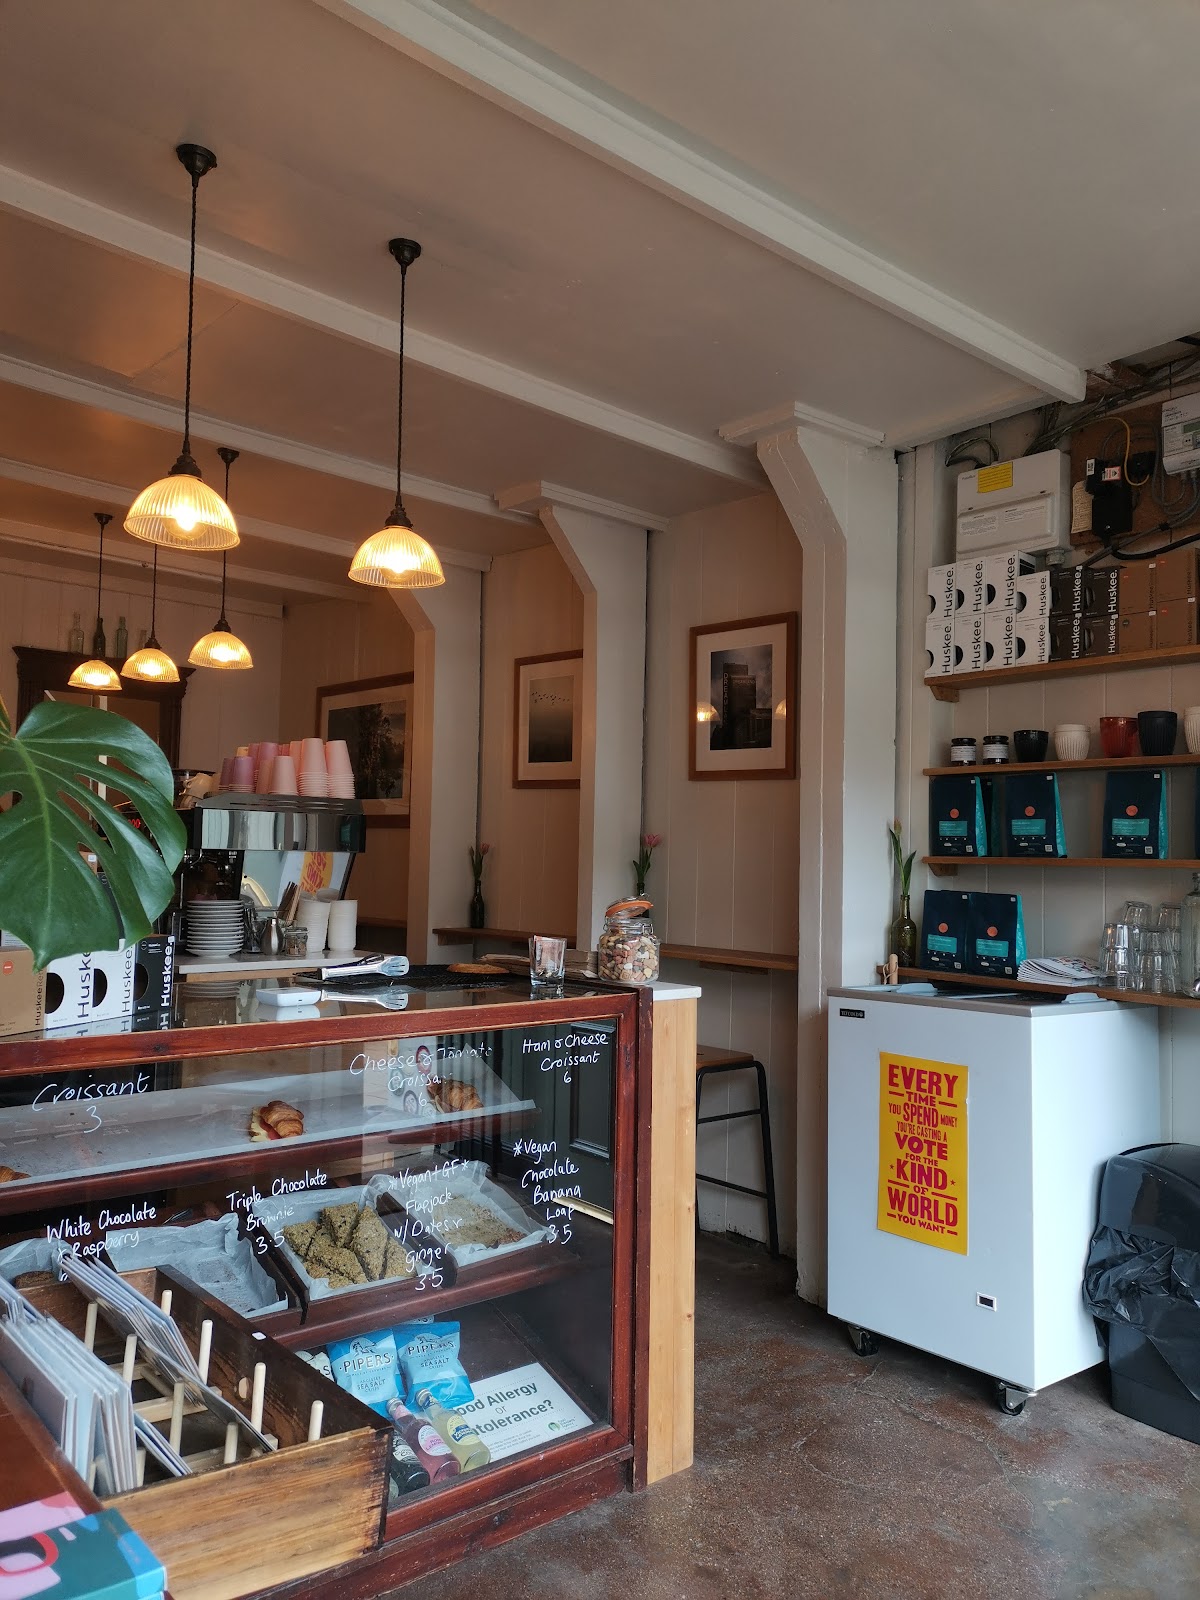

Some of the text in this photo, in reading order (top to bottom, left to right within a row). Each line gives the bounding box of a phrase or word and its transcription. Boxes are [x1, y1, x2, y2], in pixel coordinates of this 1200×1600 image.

[944, 567, 954, 618] Huskee.
[973, 560, 983, 612] Huskee.
[1005, 554, 1016, 607] Huskee.
[1108, 569, 1118, 613] Huskee.
[1039, 575, 1047, 616] Huskee.
[942, 622, 952, 674] Huskee.
[972, 617, 982, 670] Huskee.
[1003, 612, 1014, 666] Huskee.
[1038, 619, 1046, 662] Huskee.
[160, 941, 174, 1007] Huskee.
[523, 1038, 551, 1054] Ham
[564, 1033, 609, 1048] Cheese
[349, 1052, 416, 1075] Cheese
[540, 1050, 601, 1072] Croissant
[563, 1071, 572, 1084] 6
[888, 1063, 959, 1099] EVERY
[32, 1072, 151, 1112] Croissant
[418, 1092, 428, 1107] 6
[905, 1090, 937, 1107] TIME
[83, 1105, 102, 1133] 3
[888, 1102, 958, 1129] YOU SPEND MONEY
[896, 1120, 948, 1143] YOU'RE CASTING A
[894, 1131, 948, 1161] VOTE
[905, 1152, 939, 1167] FOR THE
[896, 1158, 948, 1191] KIND
[225, 1168, 328, 1212] Triple Chocolate
[405, 1187, 454, 1216] Flapjack
[533, 1184, 582, 1206] Banana
[913, 1185, 929, 1196] OF
[246, 1205, 295, 1232] Brownie
[887, 1186, 958, 1227] WORLD
[46, 1201, 157, 1244] White Chocolate
[411, 1219, 450, 1237] Dates
[897, 1213, 946, 1234] YOU WANT
[72, 1230, 140, 1258] Raspberry
[343, 1352, 393, 1373] PIPERS
[434, 1357, 450, 1366] SALT
[357, 1379, 386, 1391] SEA SALT
[456, 1382, 539, 1417] ood Allergy
[494, 1405, 507, 1415] or
[470, 1399, 555, 1437] ntolerance?
